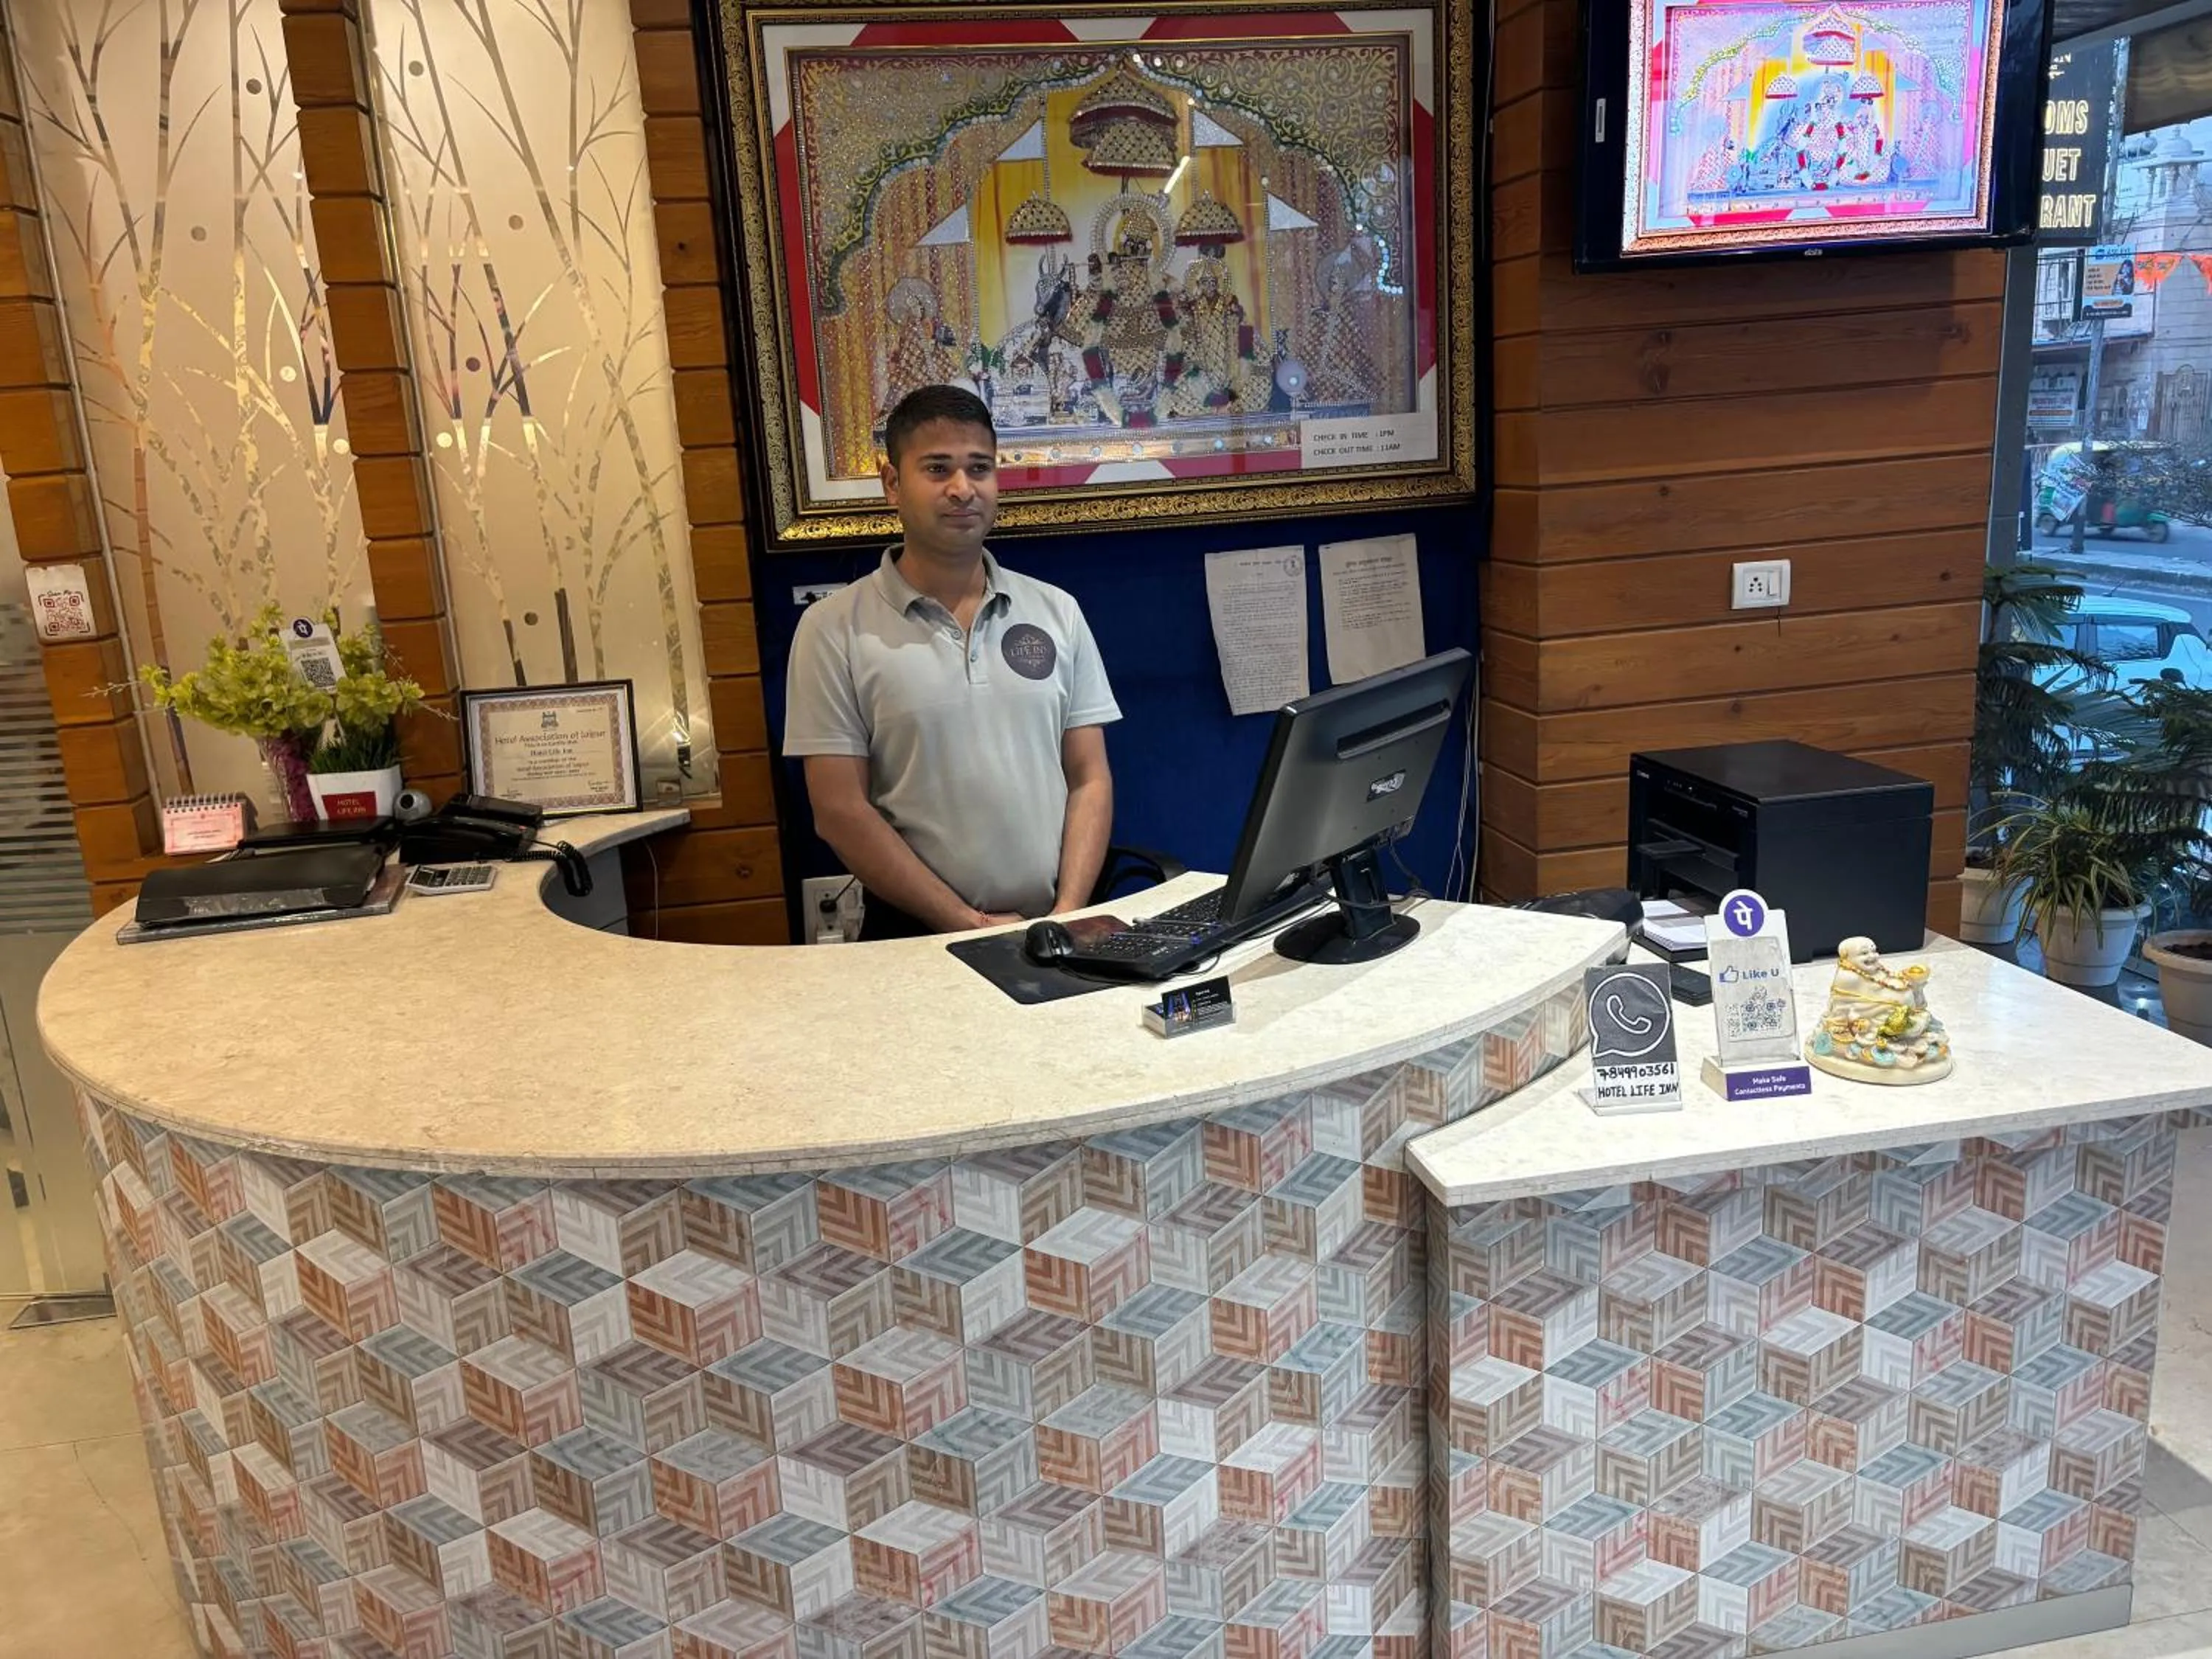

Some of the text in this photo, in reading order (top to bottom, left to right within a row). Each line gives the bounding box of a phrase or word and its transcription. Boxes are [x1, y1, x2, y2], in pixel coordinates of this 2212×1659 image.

[2042, 148, 2081, 181] UET
[2039, 195, 2096, 228] RANT
[1313, 434, 1335, 442] CHECK
[1352, 431, 1368, 439] TIME
[1313, 448, 1335, 456] CHECK
[1338, 446, 1354, 454] OUT
[1356, 445, 1373, 453] TIME
[1733, 900, 1753, 931] पे
[1742, 967, 1780, 980] Like U
[1596, 1062, 1674, 1081] 7849903561
[1753, 1074, 1787, 1085] Make Safe
[1598, 1082, 1679, 1099] HOTEL LIFE INN
[1734, 1083, 1806, 1096] Contactless Payments
